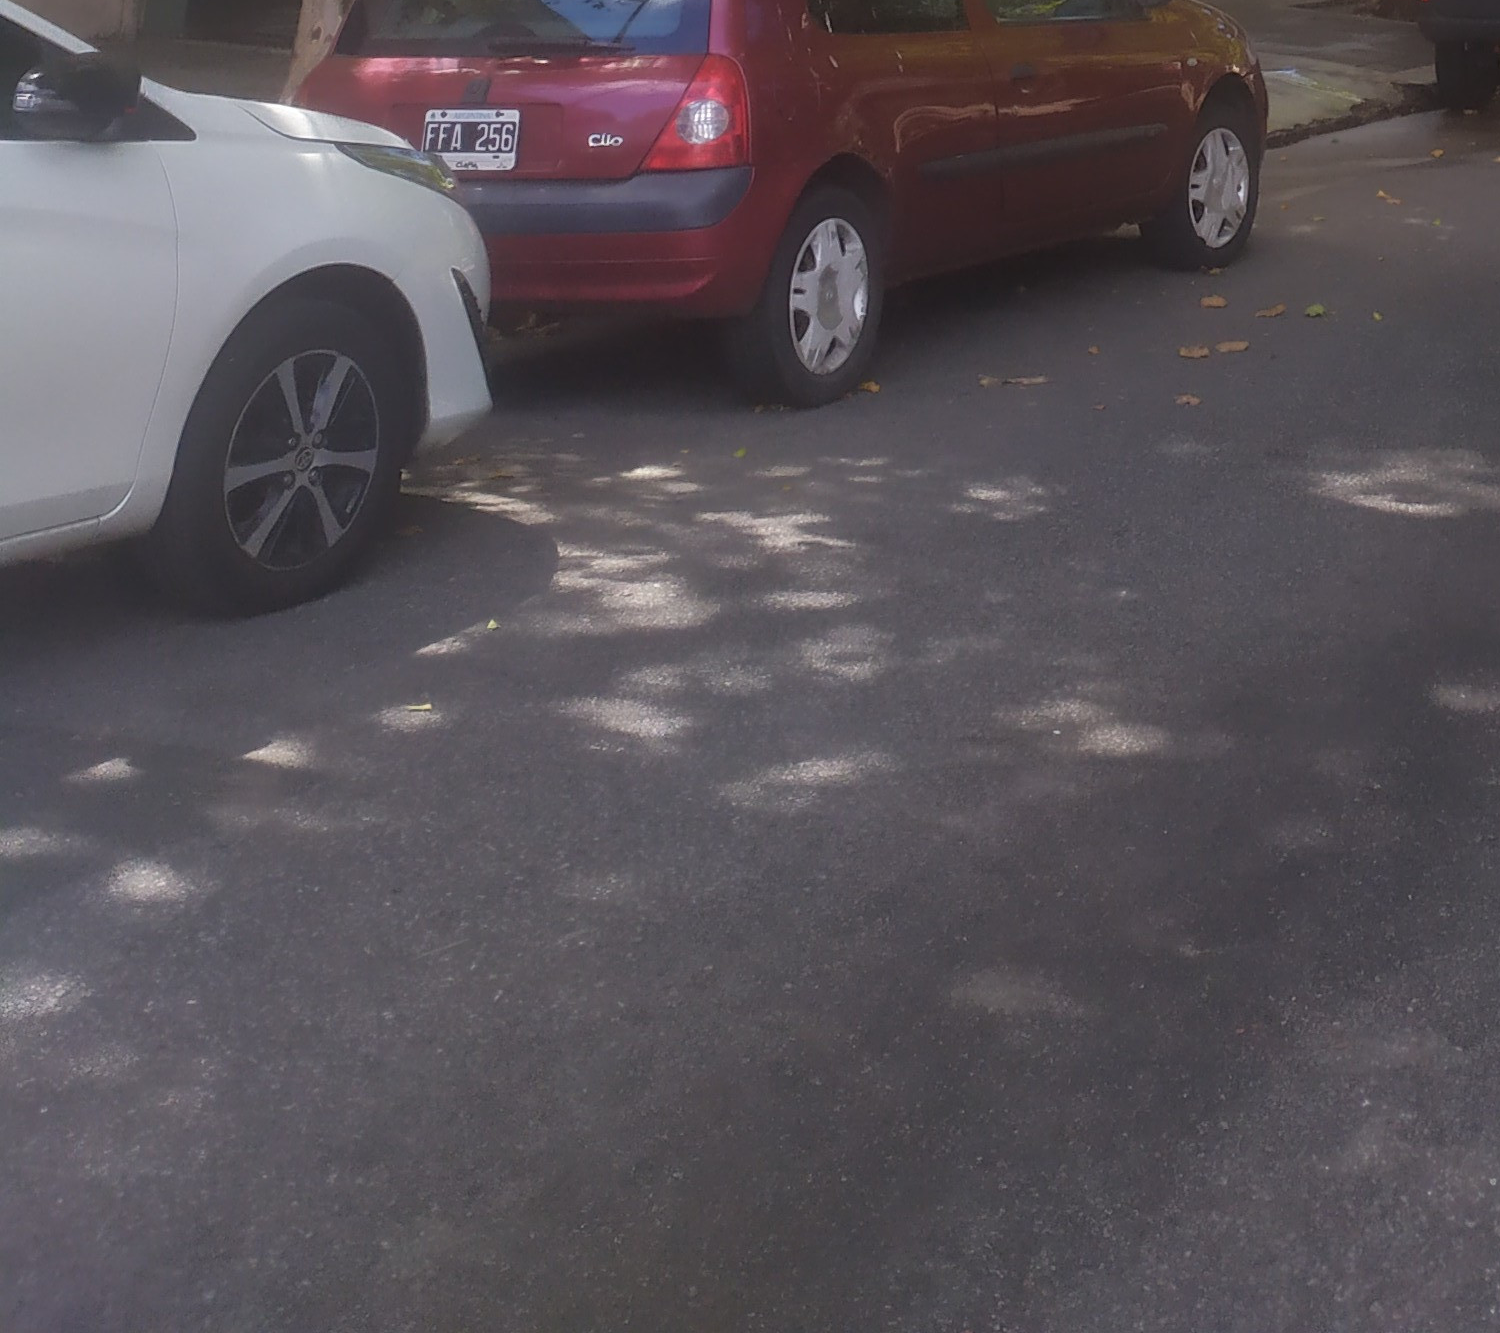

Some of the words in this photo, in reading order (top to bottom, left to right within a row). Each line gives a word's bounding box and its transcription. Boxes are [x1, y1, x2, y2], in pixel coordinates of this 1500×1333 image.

[425, 123, 462, 151] FFA
[475, 123, 514, 152] 256
[588, 133, 624, 147] Clio
